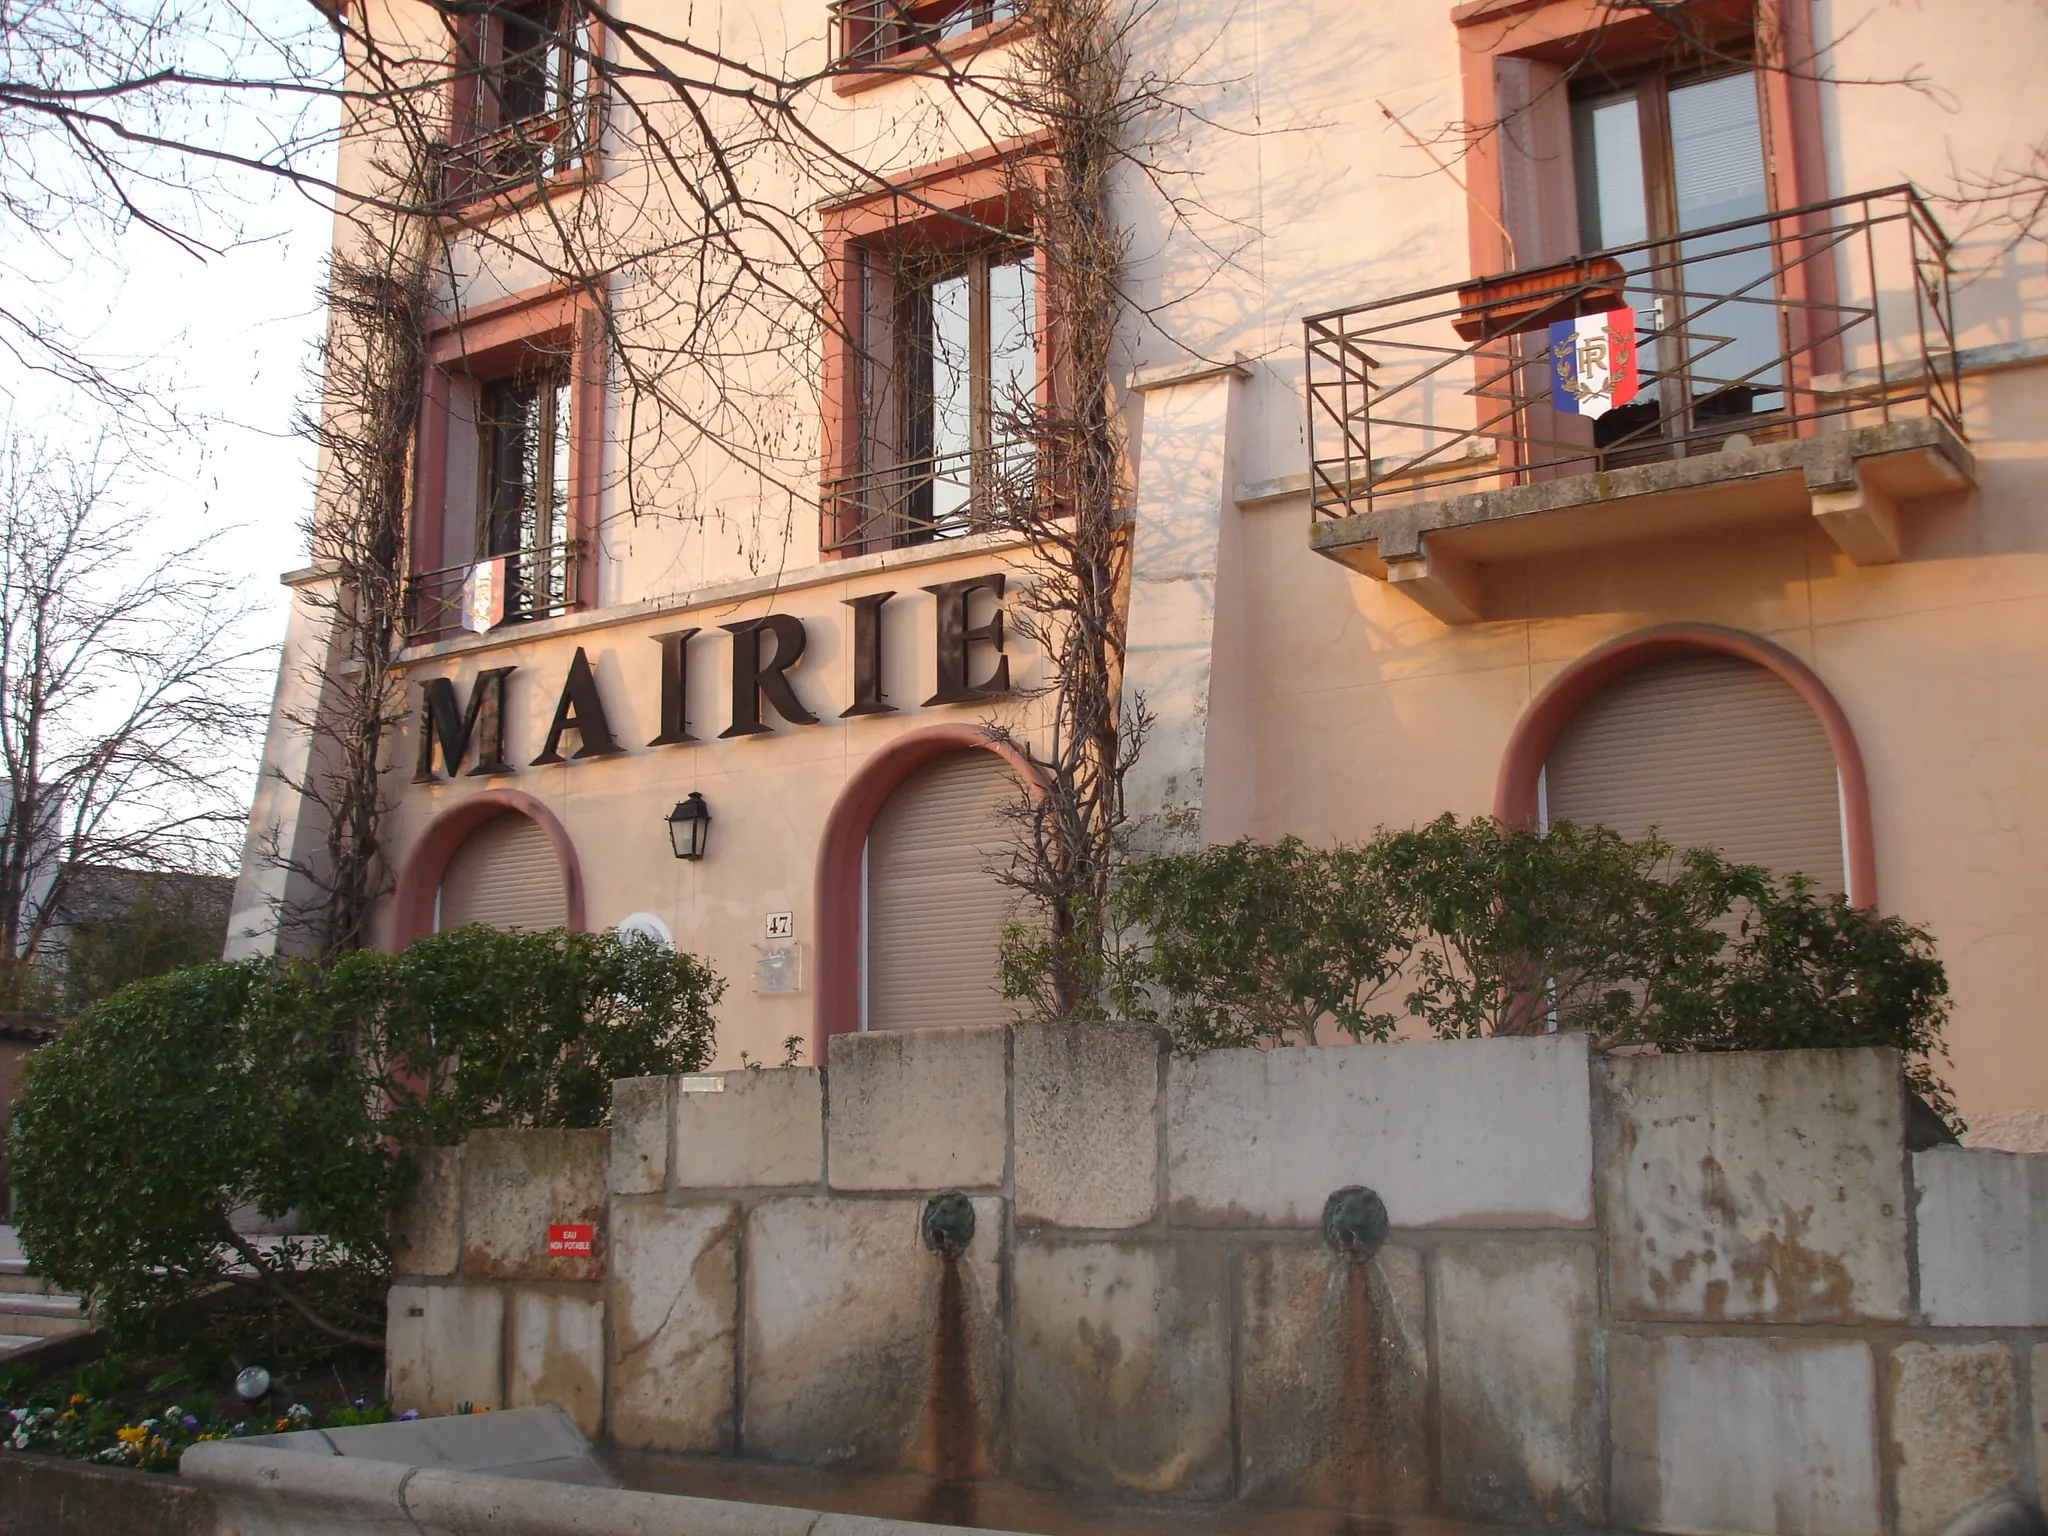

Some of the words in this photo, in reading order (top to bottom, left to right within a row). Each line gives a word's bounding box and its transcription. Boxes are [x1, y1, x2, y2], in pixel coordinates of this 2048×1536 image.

[411, 573, 1012, 784] MAIRIE
[769, 916, 788, 934] 47
[563, 1231, 577, 1239] EAU
[550, 1242, 563, 1250] NON
[564, 1242, 590, 1250] POTABLE
